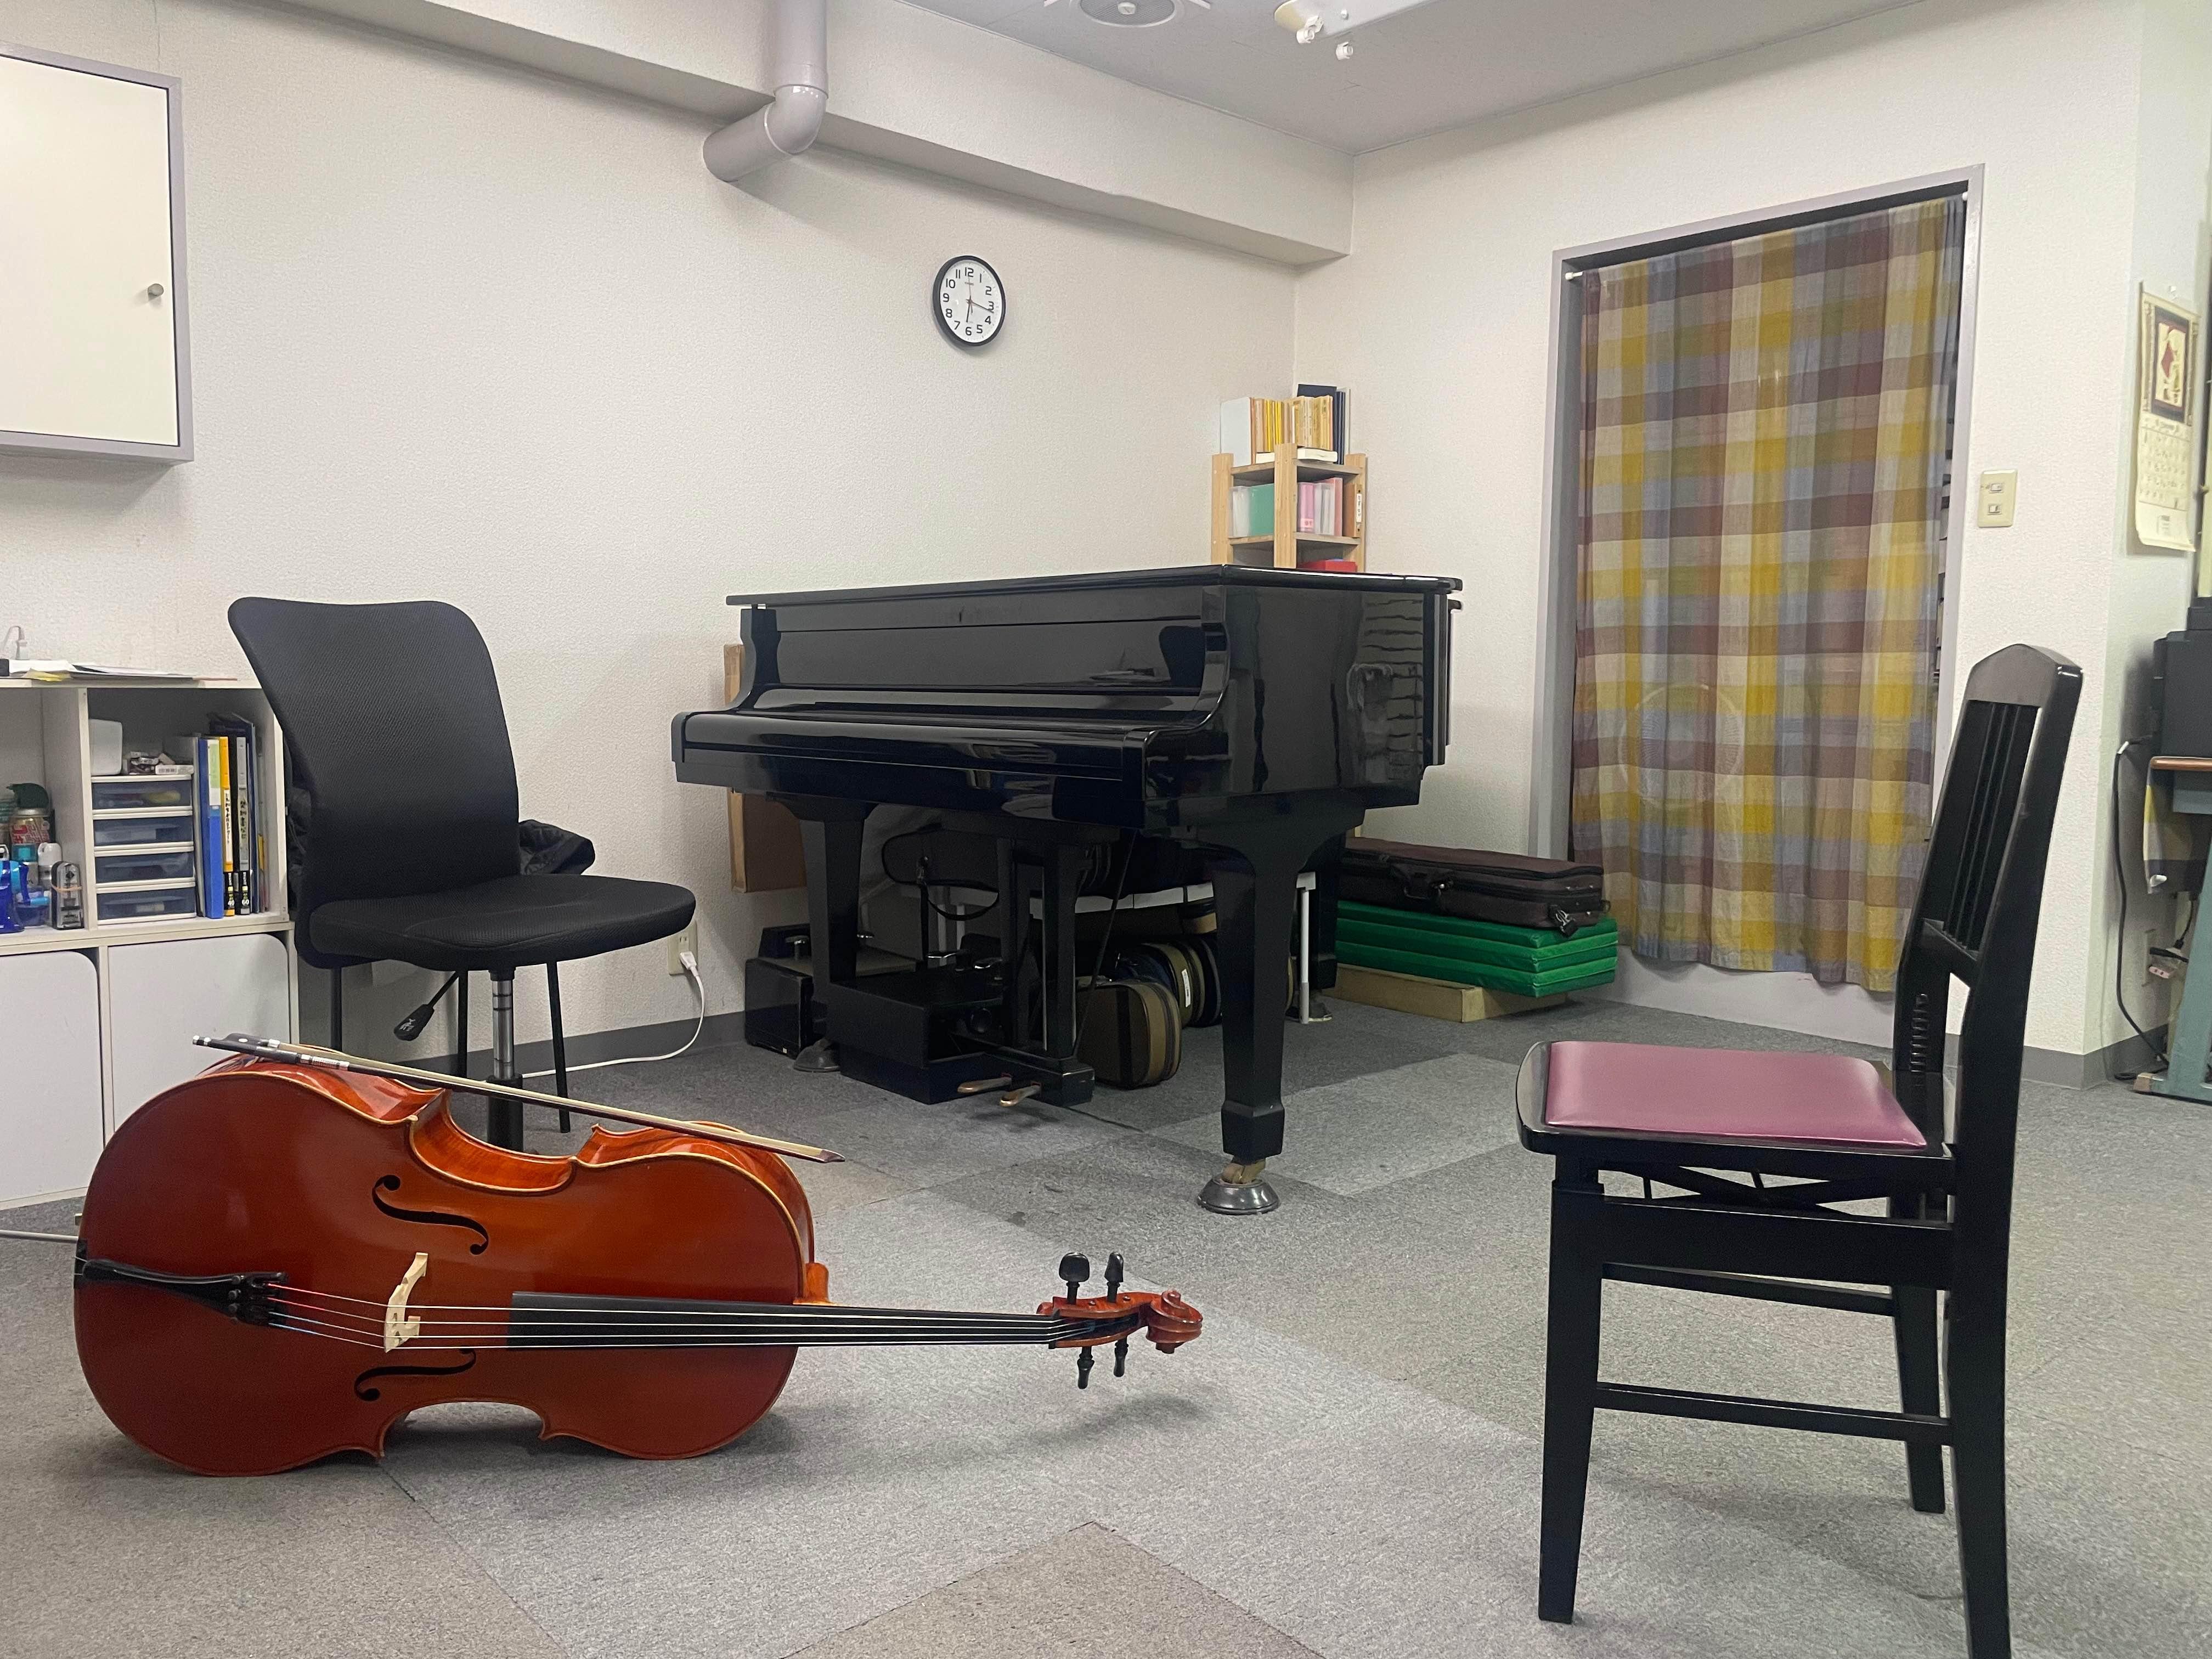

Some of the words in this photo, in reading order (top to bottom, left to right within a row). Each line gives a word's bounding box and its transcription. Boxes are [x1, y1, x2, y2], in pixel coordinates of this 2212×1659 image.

[955, 269, 961, 279] 11
[964, 267, 974, 278] 12
[946, 278, 956, 289] 10
[985, 286, 992, 296] 2
[943, 292, 950, 302] 9
[988, 301, 995, 311] 3
[945, 308, 952, 318] 8
[954, 320, 961, 330] 7
[984, 315, 991, 325] 4
[965, 326, 972, 336] 6
[976, 324, 983, 334] 5
